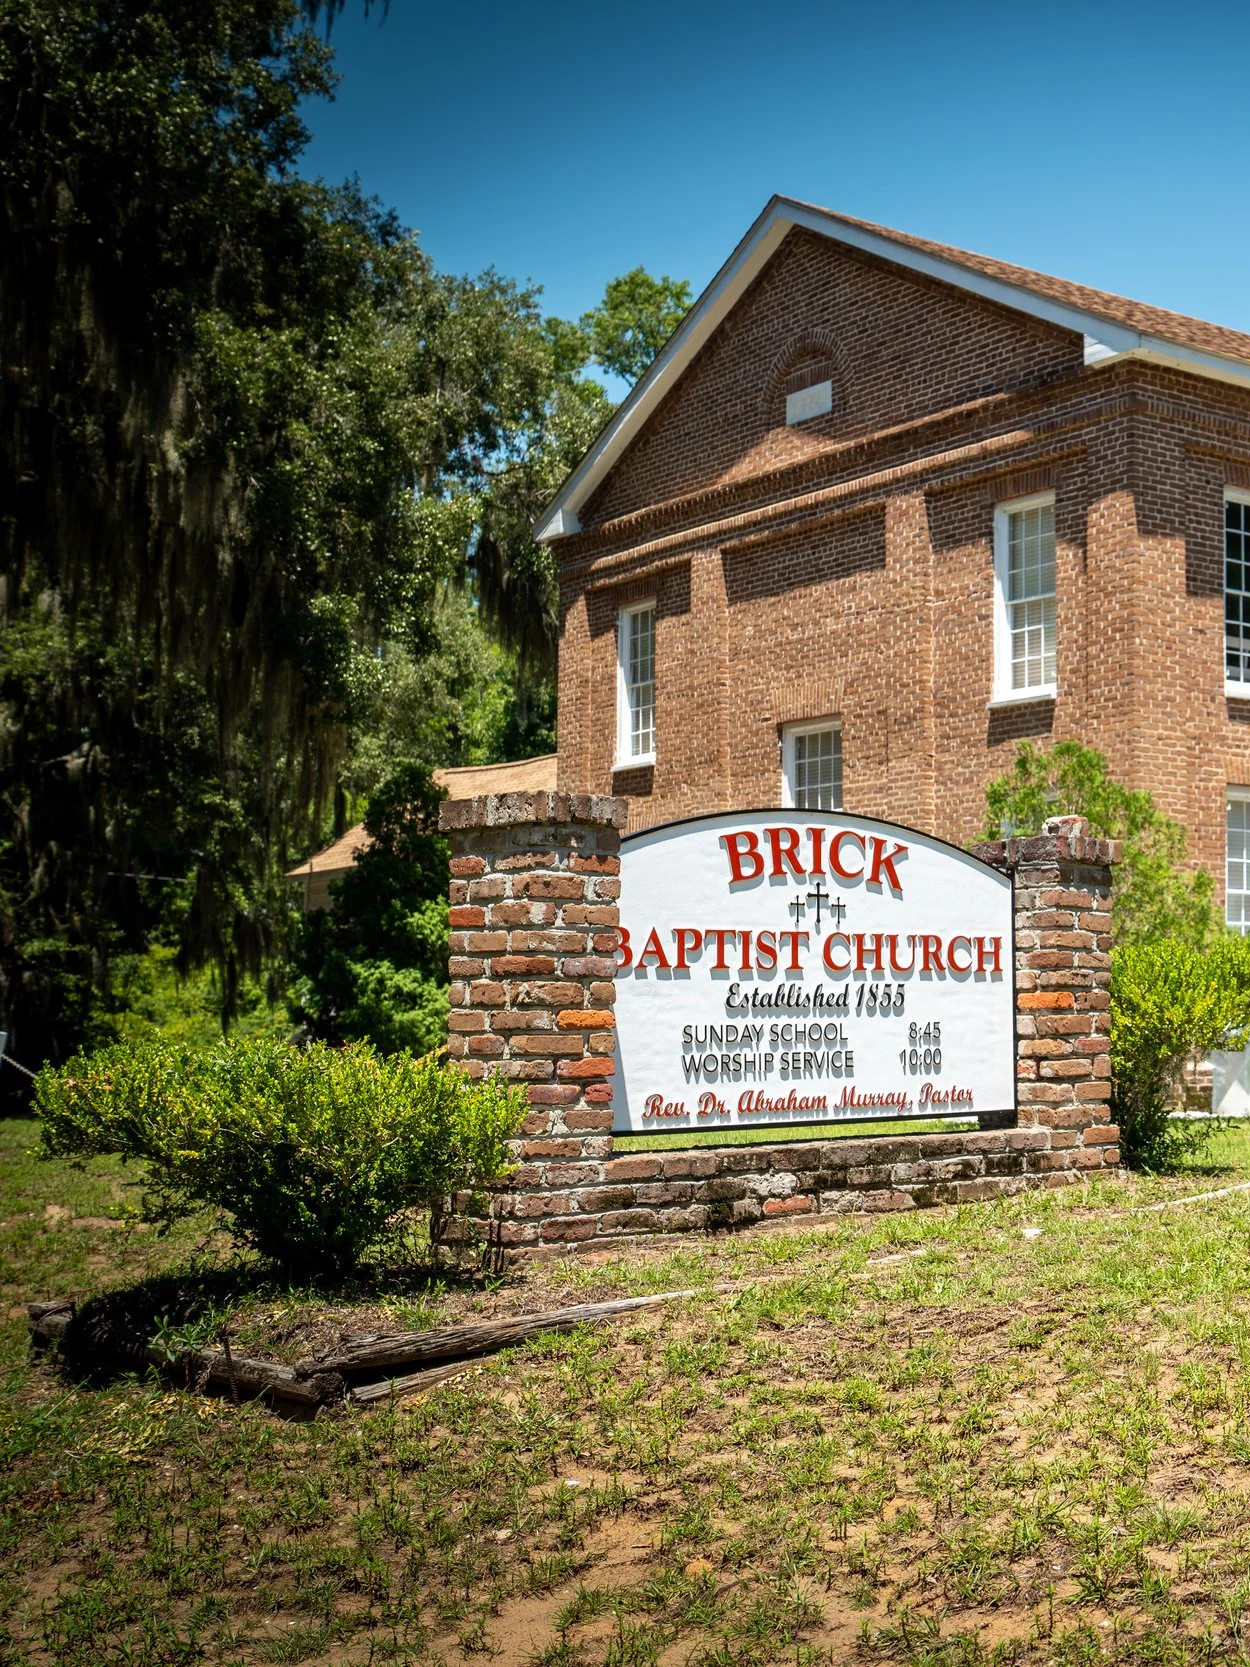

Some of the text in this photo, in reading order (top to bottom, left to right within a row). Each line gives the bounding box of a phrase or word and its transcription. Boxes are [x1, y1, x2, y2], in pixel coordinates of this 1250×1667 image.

[719, 827, 909, 892] BRICK
[614, 926, 1002, 973] BAPTIST CHURCH
[725, 982, 905, 1009] Established 1855
[682, 1021, 941, 1045] SUNDAY SCHOOL 8:45
[682, 1048, 942, 1074] WORSHIP SERVICE 10:00
[642, 1082, 974, 1119] Rev. Dr. Abraham Murray, Pastor
